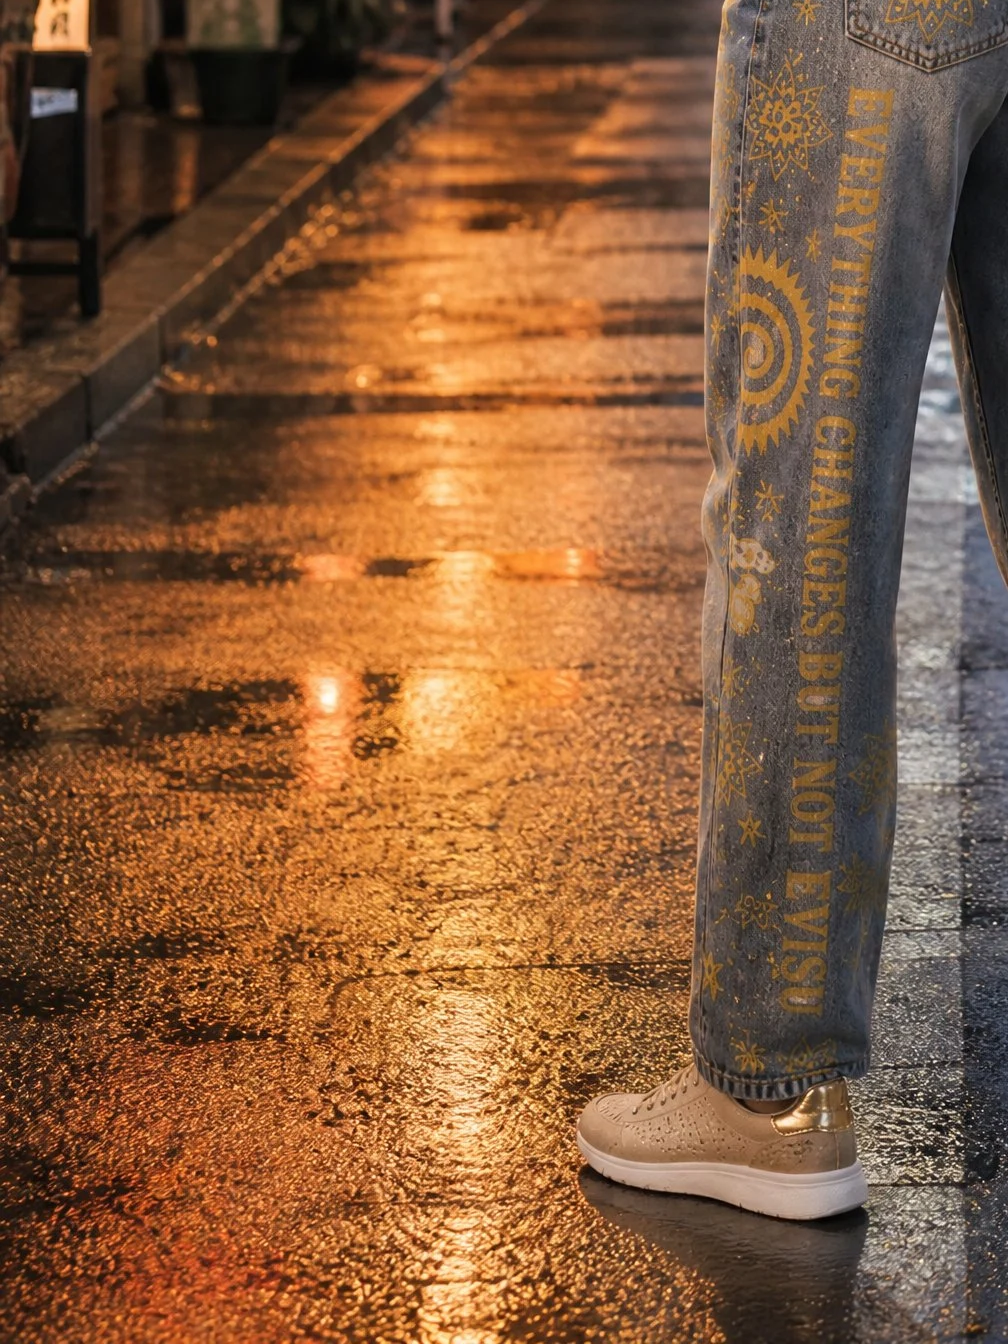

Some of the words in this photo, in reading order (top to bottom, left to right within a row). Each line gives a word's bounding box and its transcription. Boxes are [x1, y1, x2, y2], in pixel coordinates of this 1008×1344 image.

[819, 87, 895, 400] EVERYTHING
[801, 415, 857, 637] CHANGES
[795, 650, 844, 745] BUT
[788, 757, 837, 853] NOT
[778, 869, 832, 1017] EVISU
